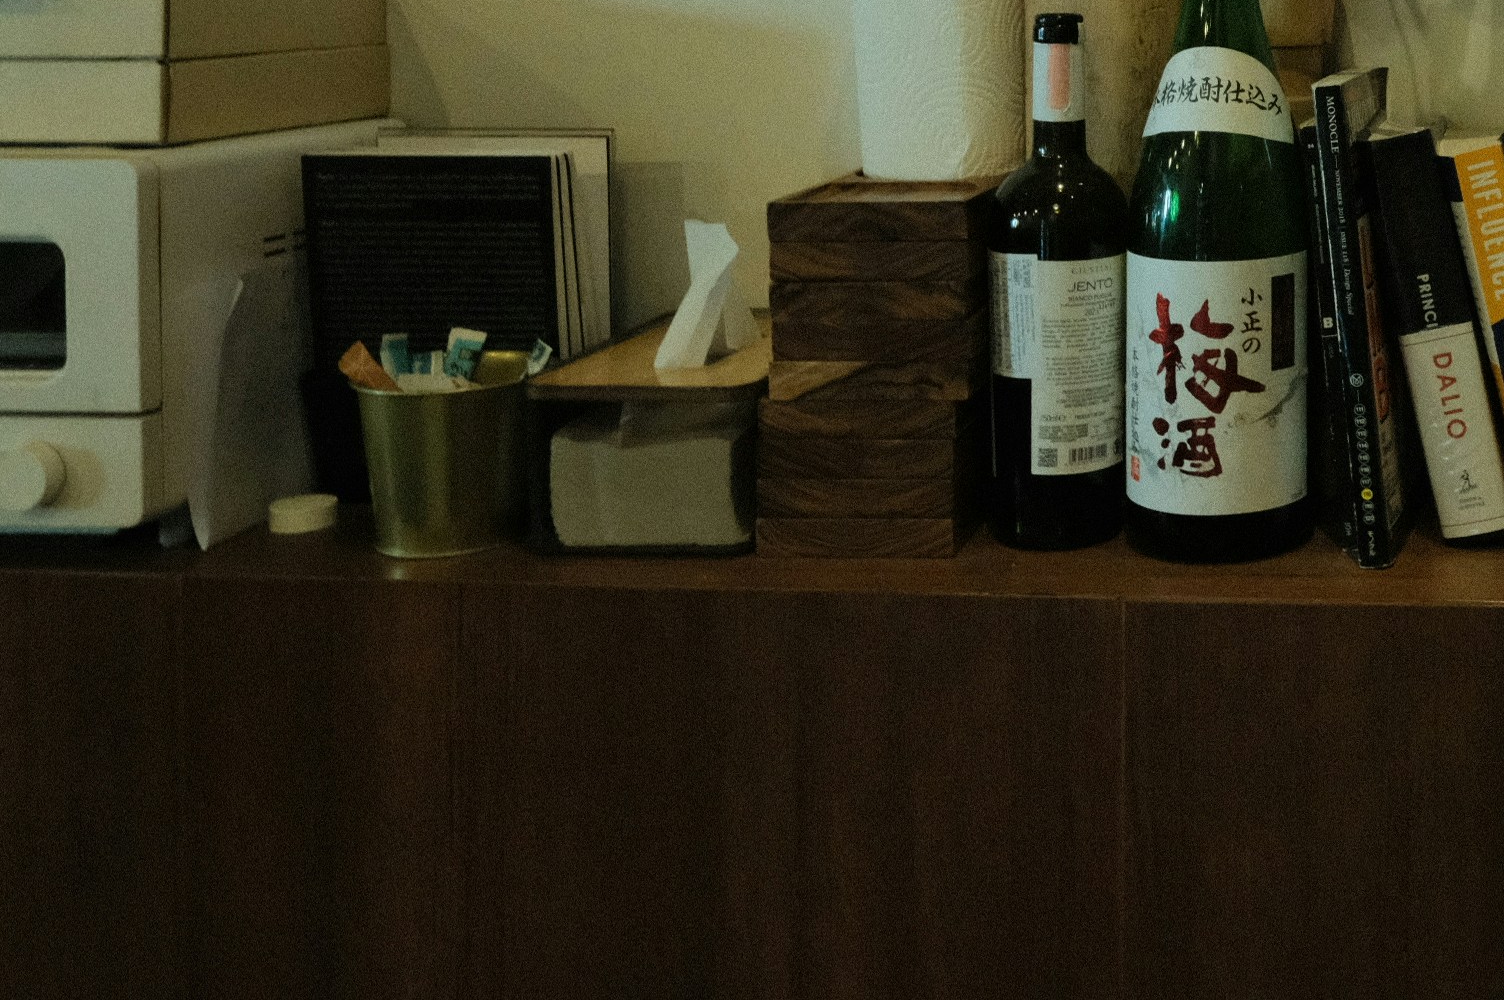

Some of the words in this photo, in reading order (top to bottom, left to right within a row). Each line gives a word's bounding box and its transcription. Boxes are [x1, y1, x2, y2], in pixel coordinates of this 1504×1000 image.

[1325, 95, 1340, 154] MONOCLE
[1067, 277, 1113, 293] JENTO
[1240, 287, 1263, 355] 小正の
[1149, 290, 1267, 479] 梅酒
[1432, 351, 1467, 440] DALIO
